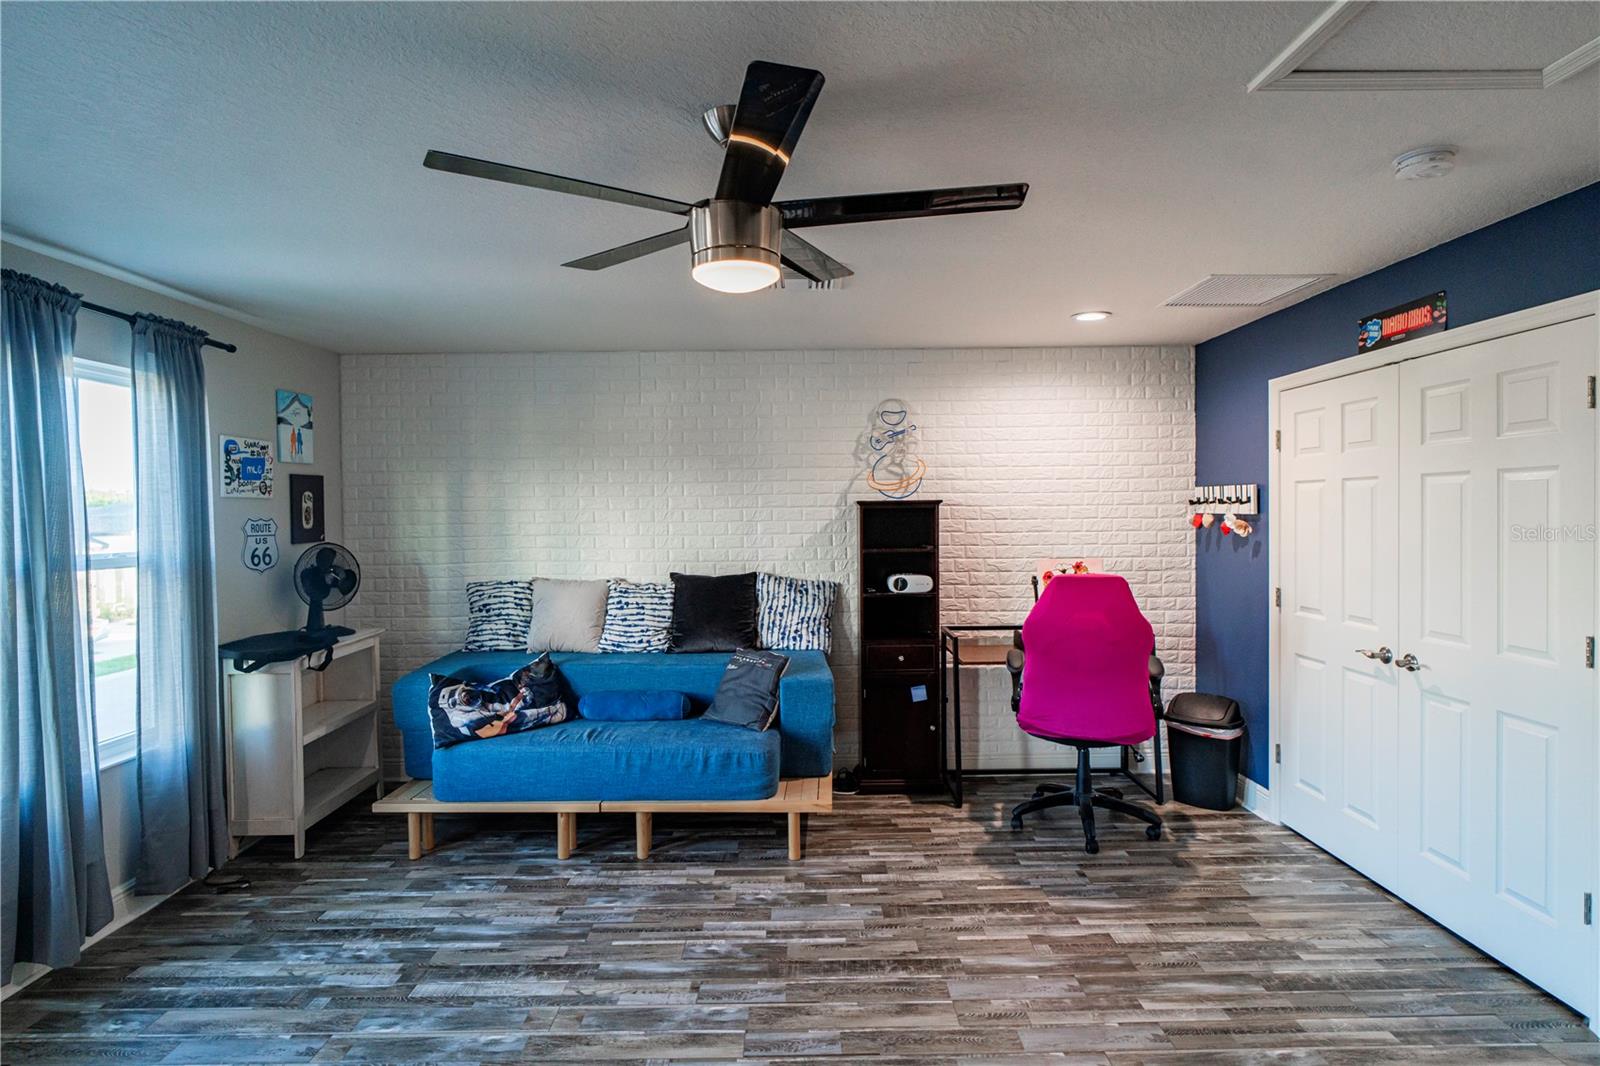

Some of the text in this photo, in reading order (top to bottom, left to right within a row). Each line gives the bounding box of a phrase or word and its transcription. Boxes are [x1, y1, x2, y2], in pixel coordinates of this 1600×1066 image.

[250, 524, 272, 533] ROUTE
[255, 537, 268, 545] US
[251, 547, 272, 567] 66
